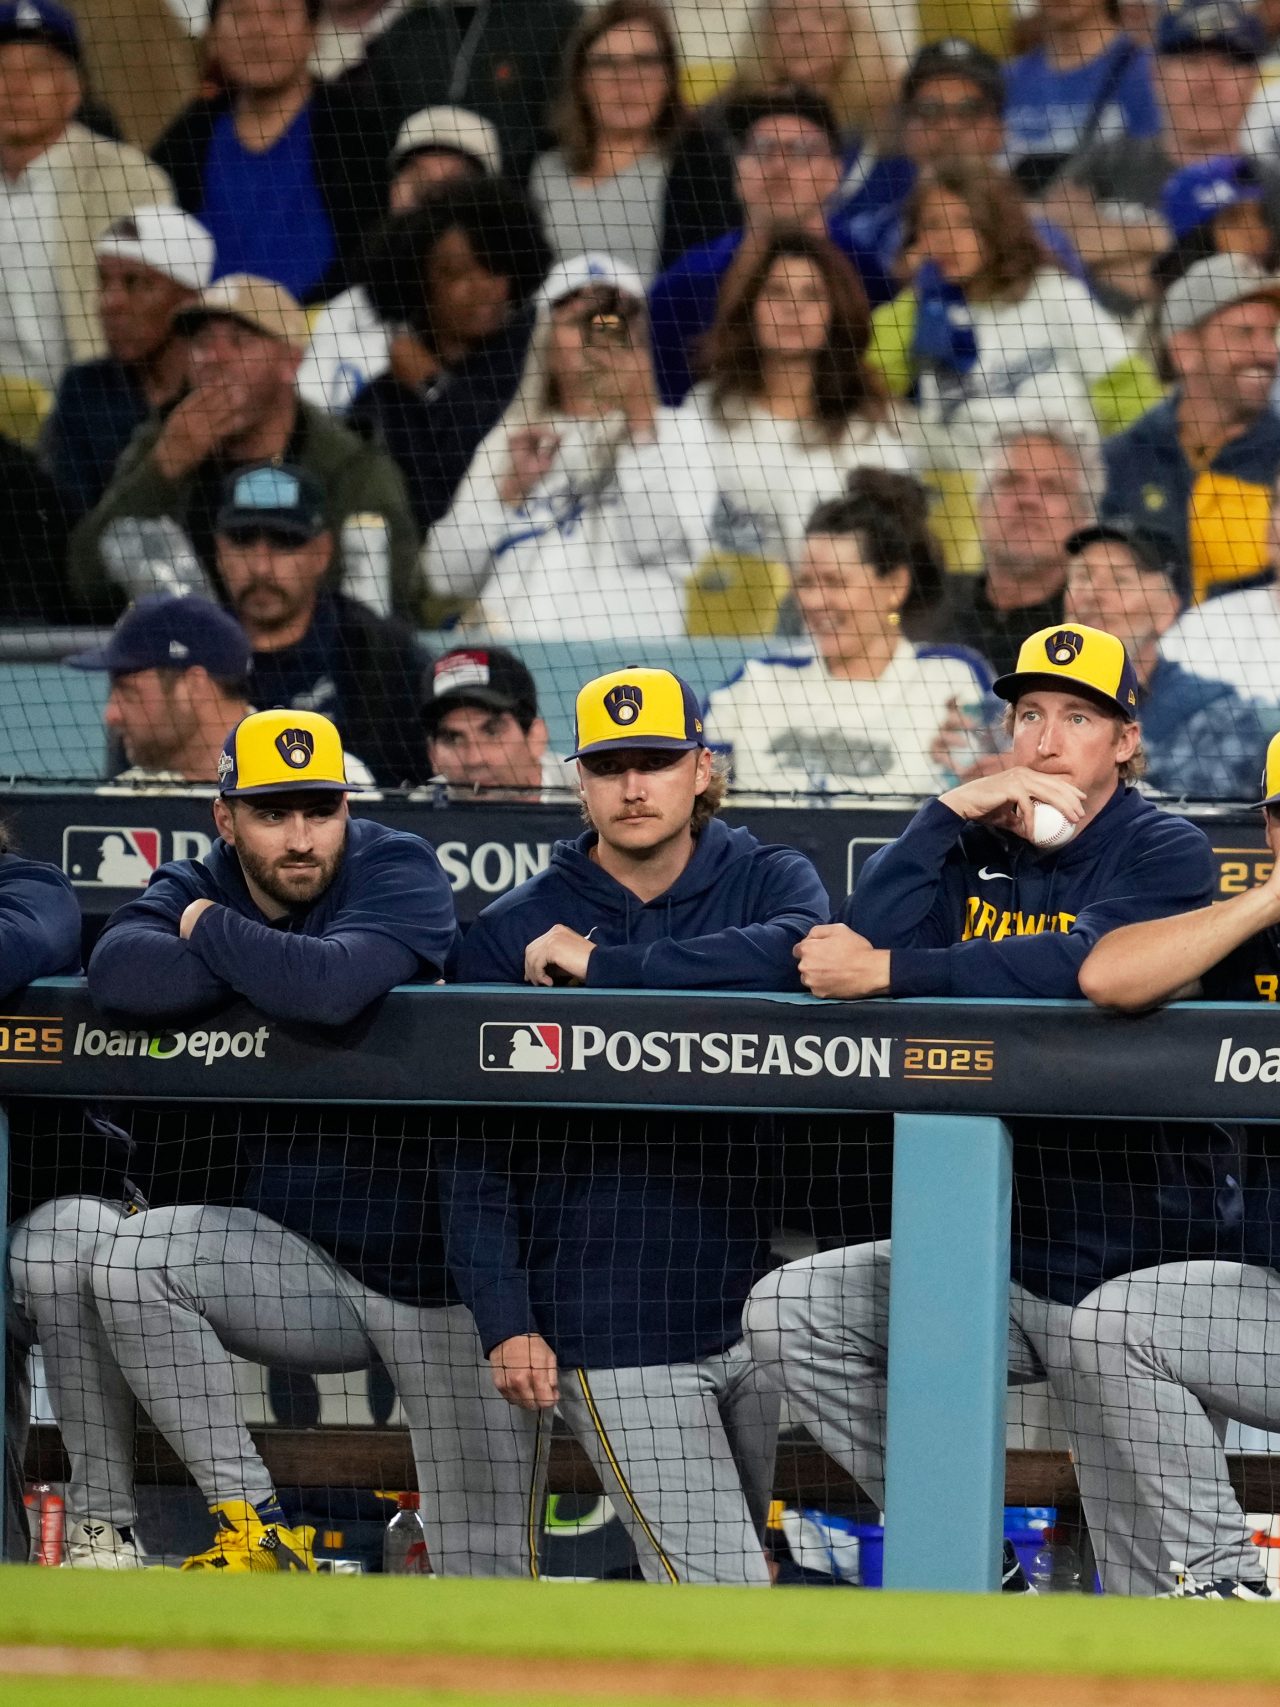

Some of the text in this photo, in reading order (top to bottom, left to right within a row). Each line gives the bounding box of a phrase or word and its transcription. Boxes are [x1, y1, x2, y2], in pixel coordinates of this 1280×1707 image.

[73, 1022, 269, 1066] loanDepot
[571, 1025, 994, 1078] POSTSEASON 2025
